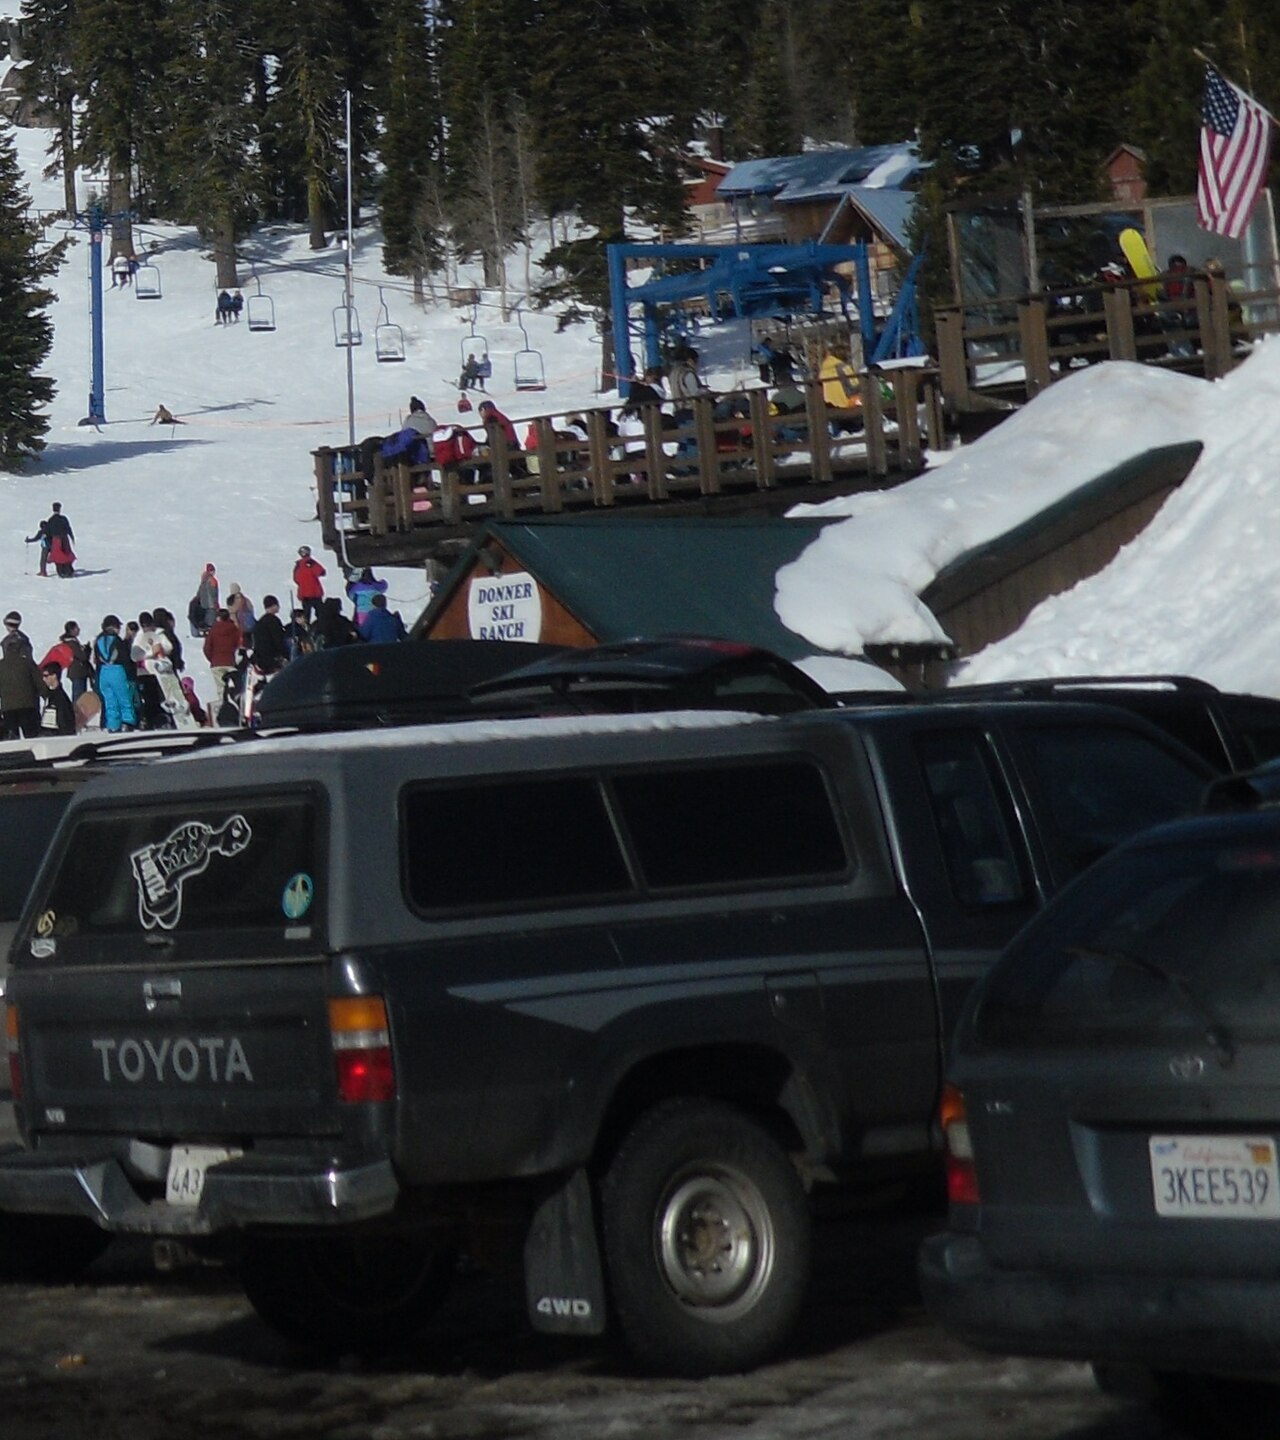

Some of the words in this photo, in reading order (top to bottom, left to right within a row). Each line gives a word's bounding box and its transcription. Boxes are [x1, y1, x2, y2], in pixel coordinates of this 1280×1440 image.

[478, 582, 532, 604] DONNER
[491, 603, 515, 622] SKI
[479, 621, 525, 641] RANCH
[92, 1038, 255, 1082] TOYOTA
[1161, 1167, 1270, 1206] 3KEE539
[536, 1296, 592, 1317] 4WD
